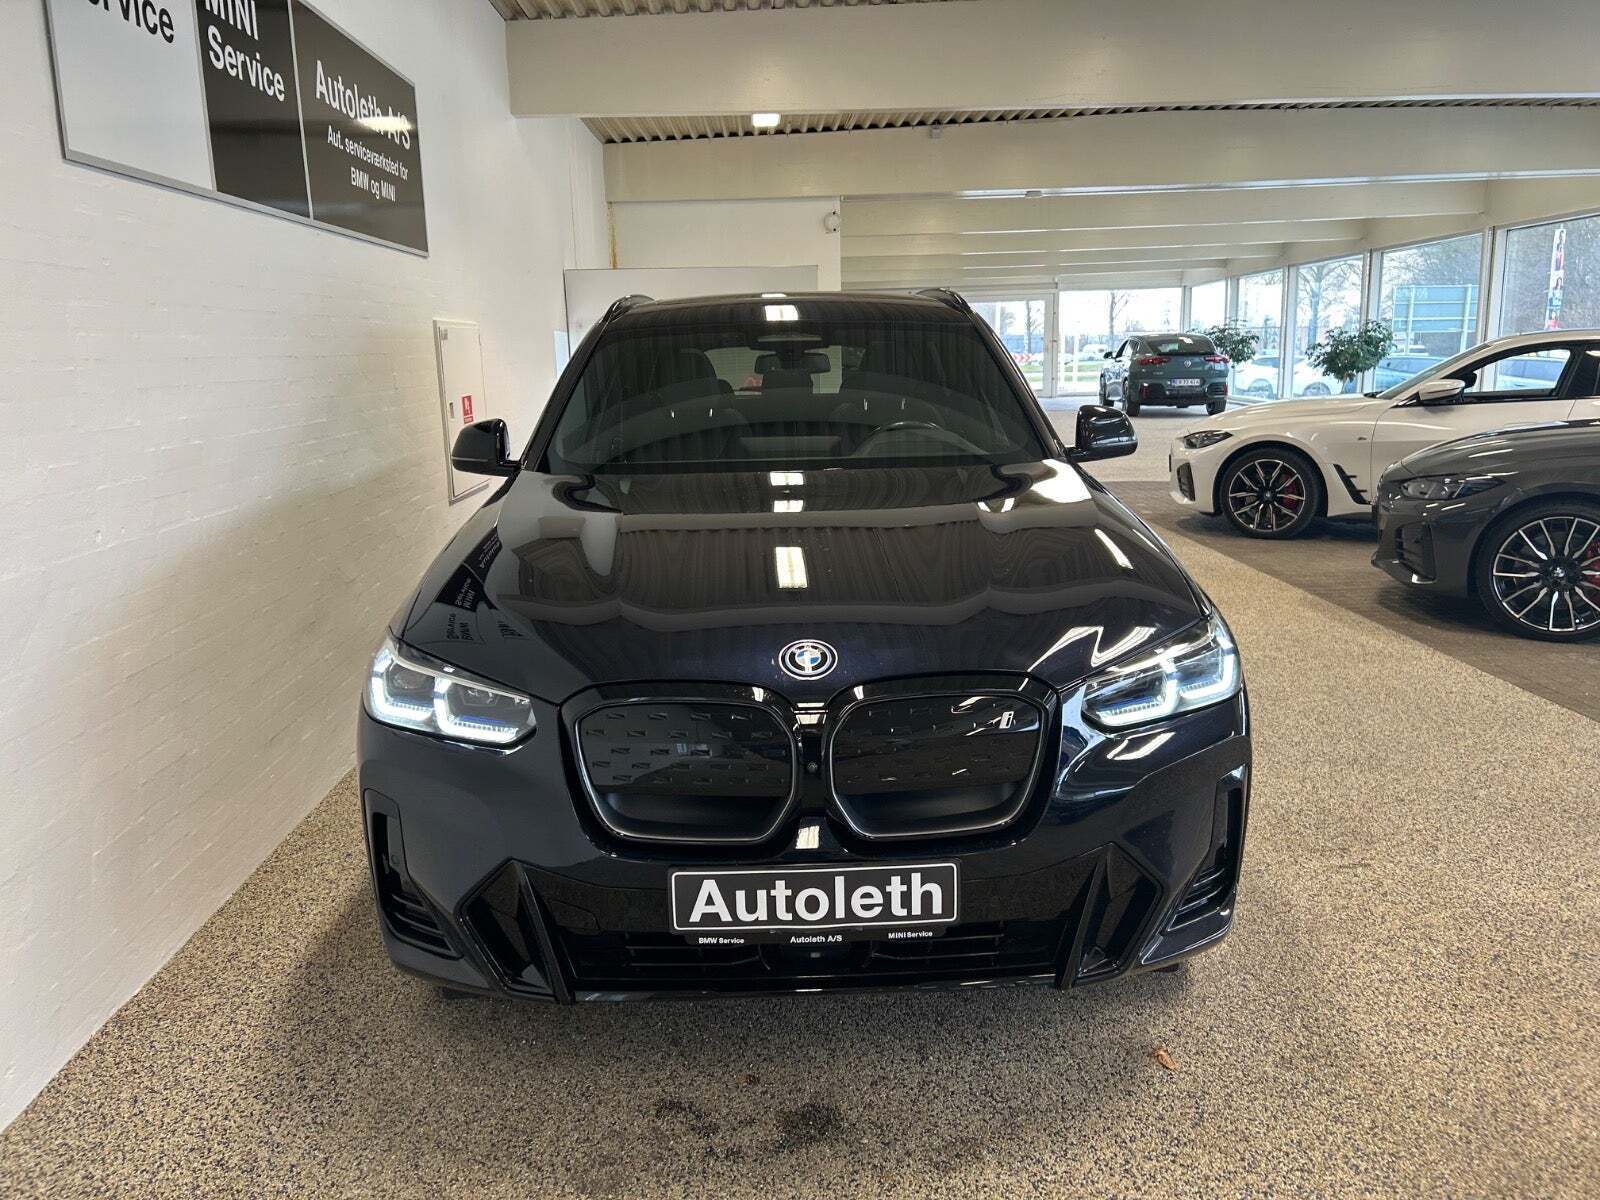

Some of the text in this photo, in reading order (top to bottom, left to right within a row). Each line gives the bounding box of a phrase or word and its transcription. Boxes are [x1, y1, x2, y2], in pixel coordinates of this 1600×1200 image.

[207, 25, 285, 102] Service
[316, 60, 384, 135] Autoleth
[327, 124, 343, 150] Aut.
[400, 162, 409, 180] for
[351, 166, 396, 202] BMW og MINI
[689, 873, 943, 922] Autoleth
[790, 934, 842, 943] Autoleth A/S
[888, 930, 933, 939] MINI Service
